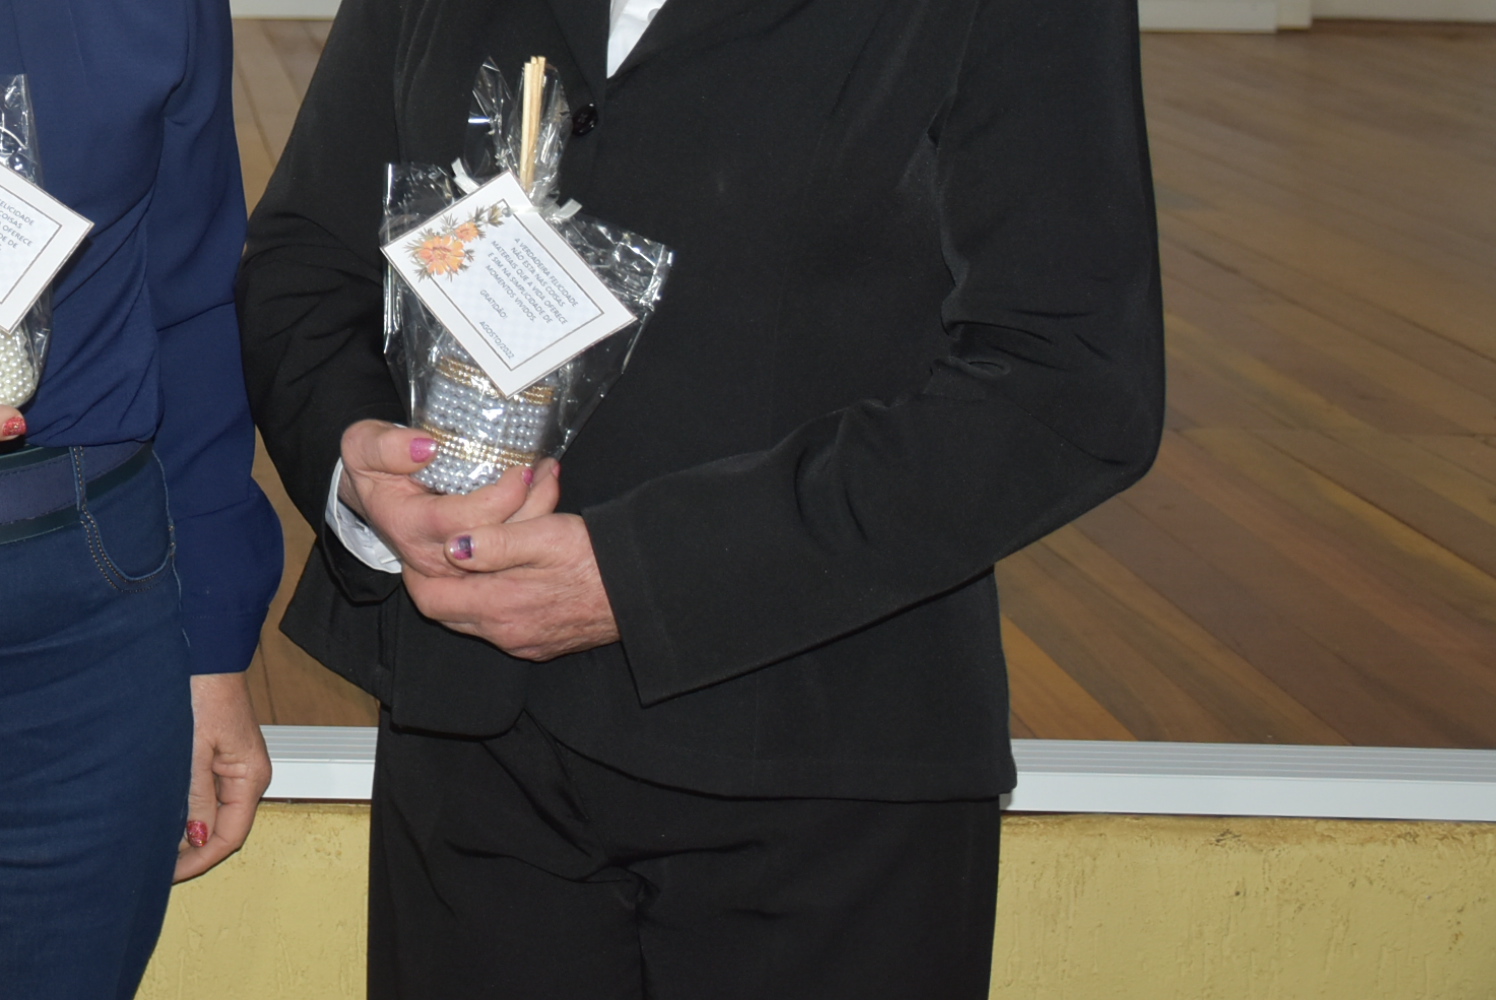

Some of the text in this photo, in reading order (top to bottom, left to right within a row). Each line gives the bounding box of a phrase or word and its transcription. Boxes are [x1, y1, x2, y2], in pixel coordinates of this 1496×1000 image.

[3, 225, 33, 247] OFERECE
[486, 265, 515, 299] MOMENTOS
[491, 241, 517, 270] MATERIAIS
[516, 268, 528, 282] QUE
[533, 285, 544, 300] VIDA
[544, 299, 568, 325] OFERECE
[493, 257, 503, 269] SIM
[510, 276, 545, 313] SIMPLICIDADE
[510, 248, 524, 260] NÃO
[535, 273, 547, 287] NAS
[546, 285, 564, 307] COISAS
[520, 242, 551, 277] VERDADEIRA
[551, 275, 578, 307] FELICIDADE
